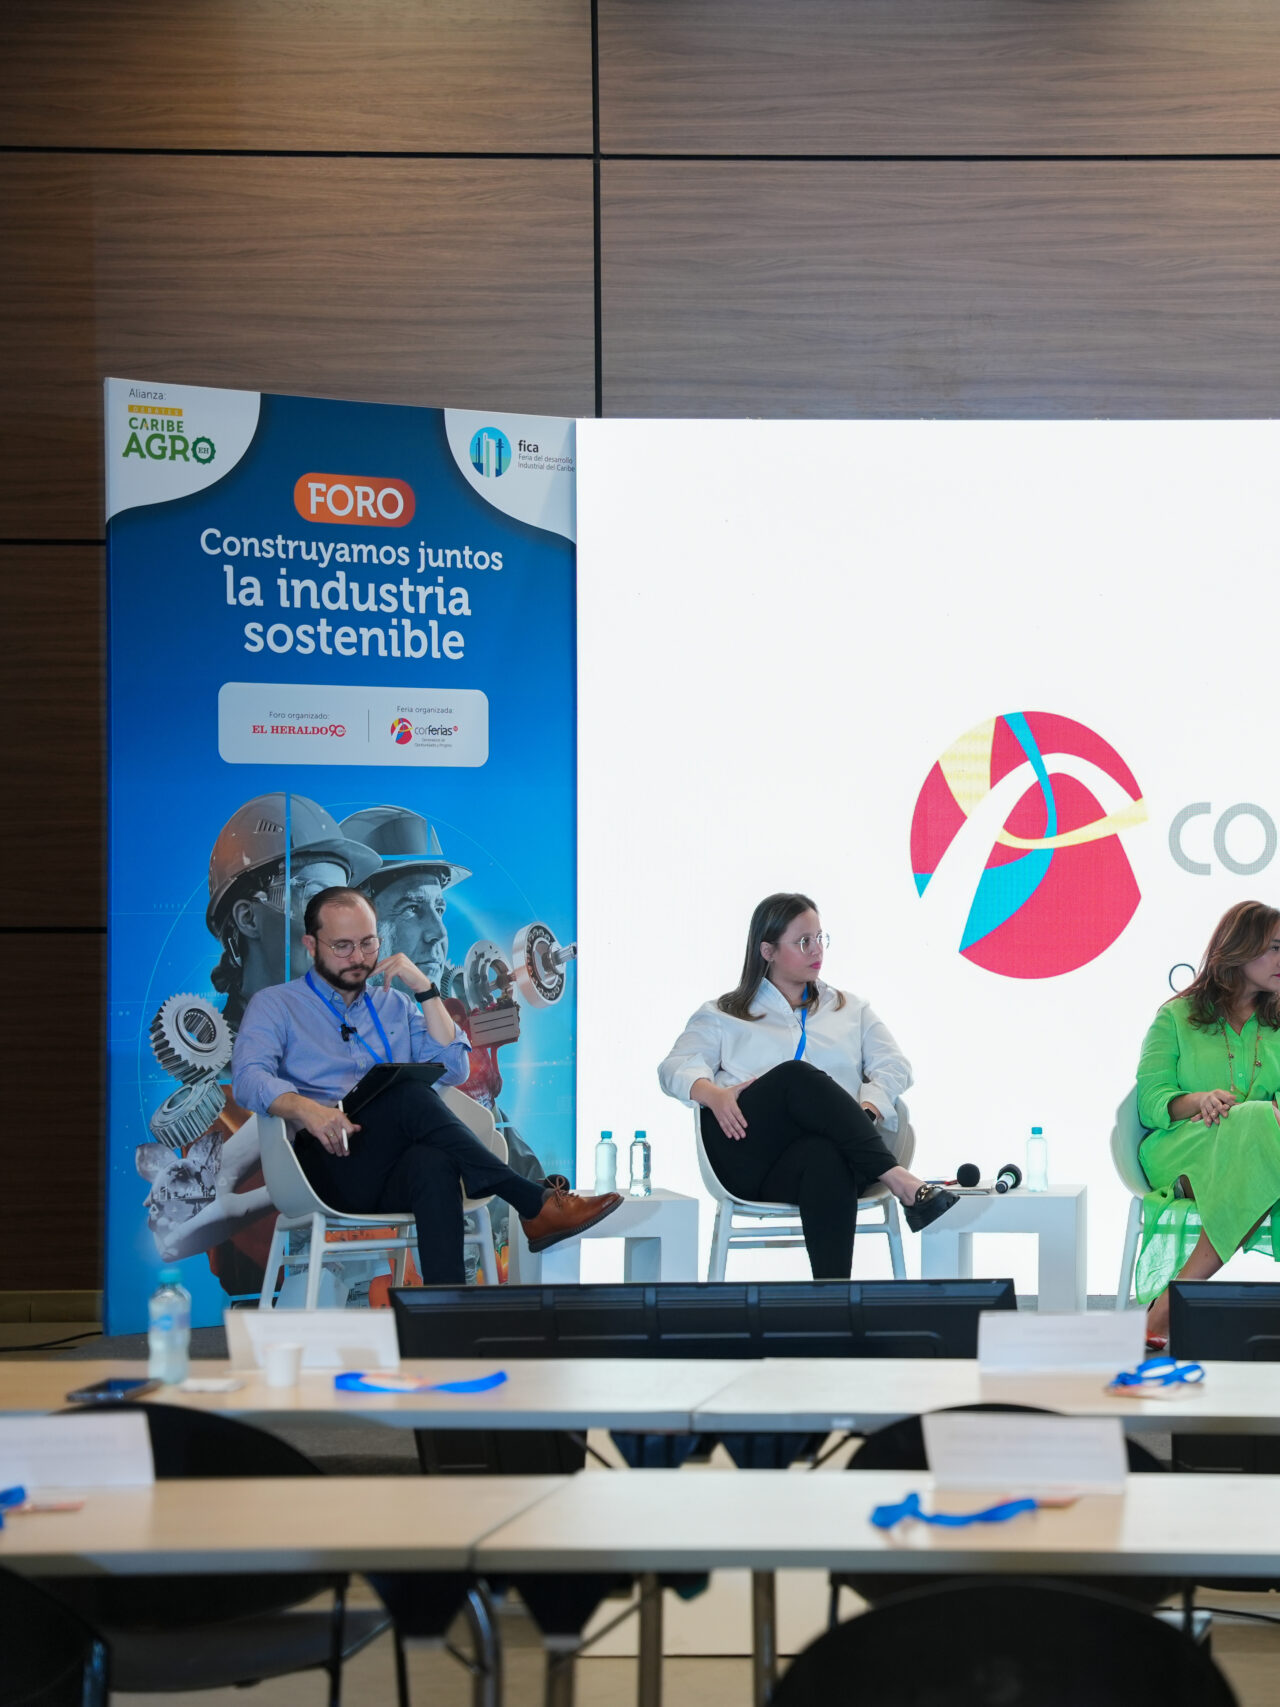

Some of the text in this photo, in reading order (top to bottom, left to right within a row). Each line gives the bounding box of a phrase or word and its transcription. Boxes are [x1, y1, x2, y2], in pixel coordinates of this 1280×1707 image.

[128, 388, 168, 401] Alianza:
[128, 417, 184, 433] CARIBE
[122, 431, 216, 465] AGRO
[517, 439, 539, 453] fica
[308, 482, 404, 520] FORO
[200, 527, 504, 573] Construyamos juntos
[223, 564, 472, 616] la industria
[243, 618, 465, 660] sostenible
[252, 725, 268, 734] EL
[270, 725, 329, 736] HERALDO
[414, 724, 453, 736] corferias
